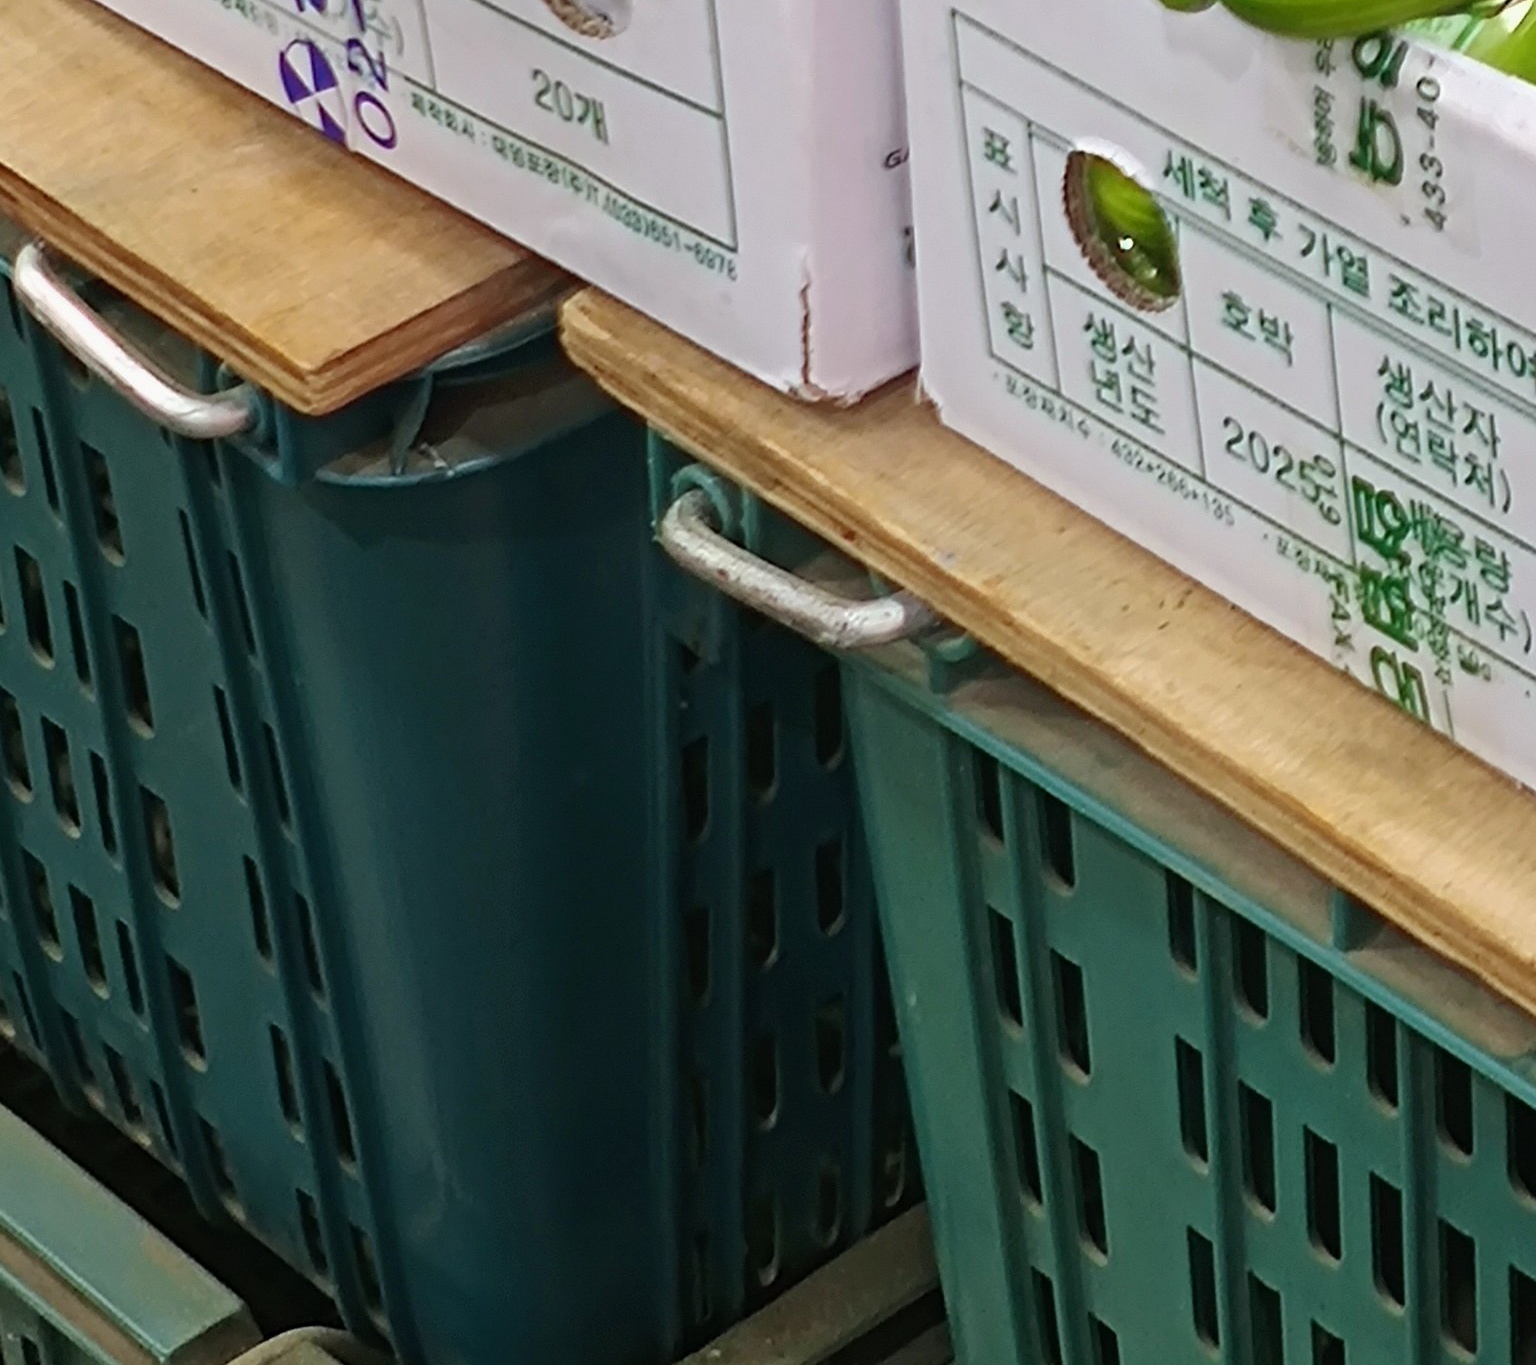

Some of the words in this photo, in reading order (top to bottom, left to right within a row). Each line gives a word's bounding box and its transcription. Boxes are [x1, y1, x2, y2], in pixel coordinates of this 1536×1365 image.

[531, 68, 611, 147] 20개
[1162, 148, 1232, 222] 세척
[1246, 194, 1284, 244] 후
[1297, 222, 1373, 300] 가열
[1082, 310, 1156, 386] 생산
[1219, 289, 1295, 368] 호박
[1090, 358, 1167, 437] 년도
[1376, 353, 1502, 461] 생산자
[1222, 415, 1320, 506] 2025
[1376, 401, 1512, 515] (연락처)
